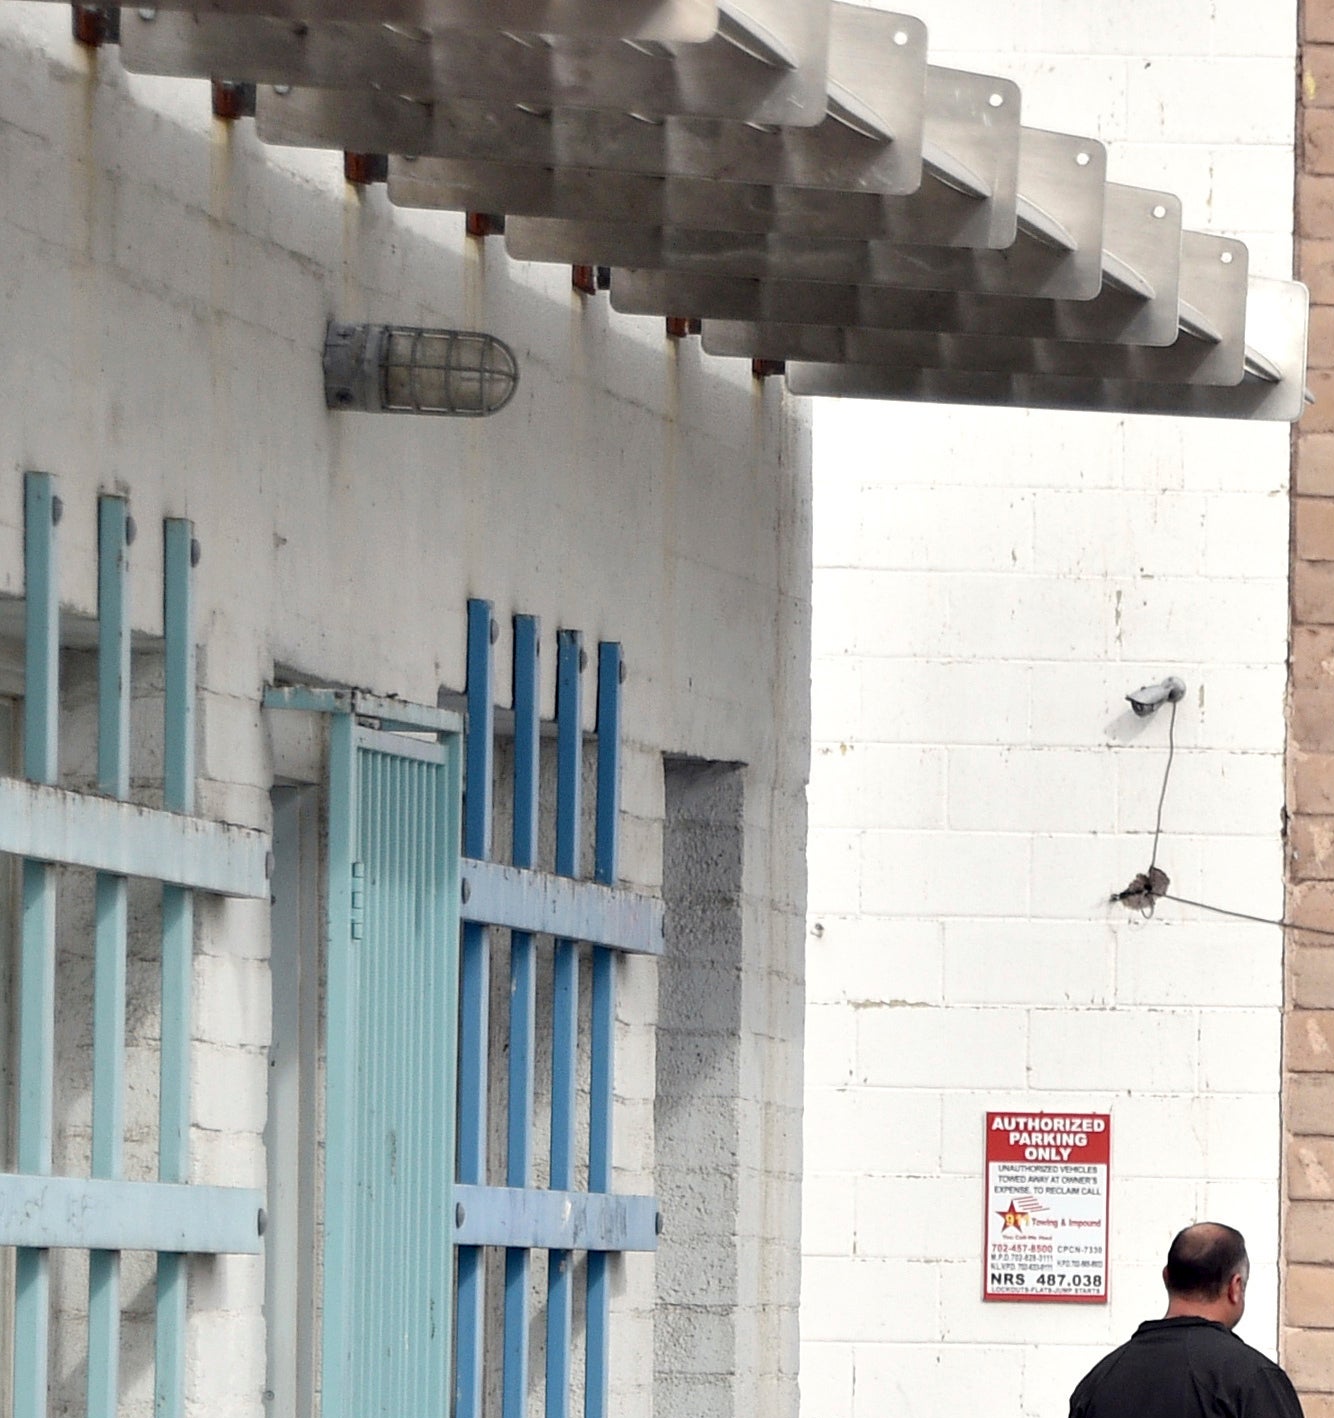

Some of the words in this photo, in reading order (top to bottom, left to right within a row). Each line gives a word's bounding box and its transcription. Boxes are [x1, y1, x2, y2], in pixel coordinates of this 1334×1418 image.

[991, 1117, 1106, 1132] AUTHORIZED
[1009, 1132, 1088, 1147] PARKING
[1024, 1147, 1072, 1161] ONLY
[998, 1165, 1059, 1173] UNAUTHORIZED
[1060, 1166, 1098, 1174] VEHICLES
[998, 1175, 1027, 1183] TOWED
[1050, 1176, 1060, 1184] AT
[1061, 1176, 1098, 1185] OWNER'S
[1033, 1186, 1044, 1194] TO
[1045, 1187, 1080, 1195] RECLAIM
[1081, 1187, 1102, 1196] CALL
[1005, 1214, 1031, 1227] 911
[1031, 1218, 1059, 1229] Towing
[1060, 1218, 1067, 1227] &
[1069, 1219, 1102, 1229] Impound
[990, 1272, 1025, 1286] NRS
[1036, 1274, 1102, 1287] 487.038
